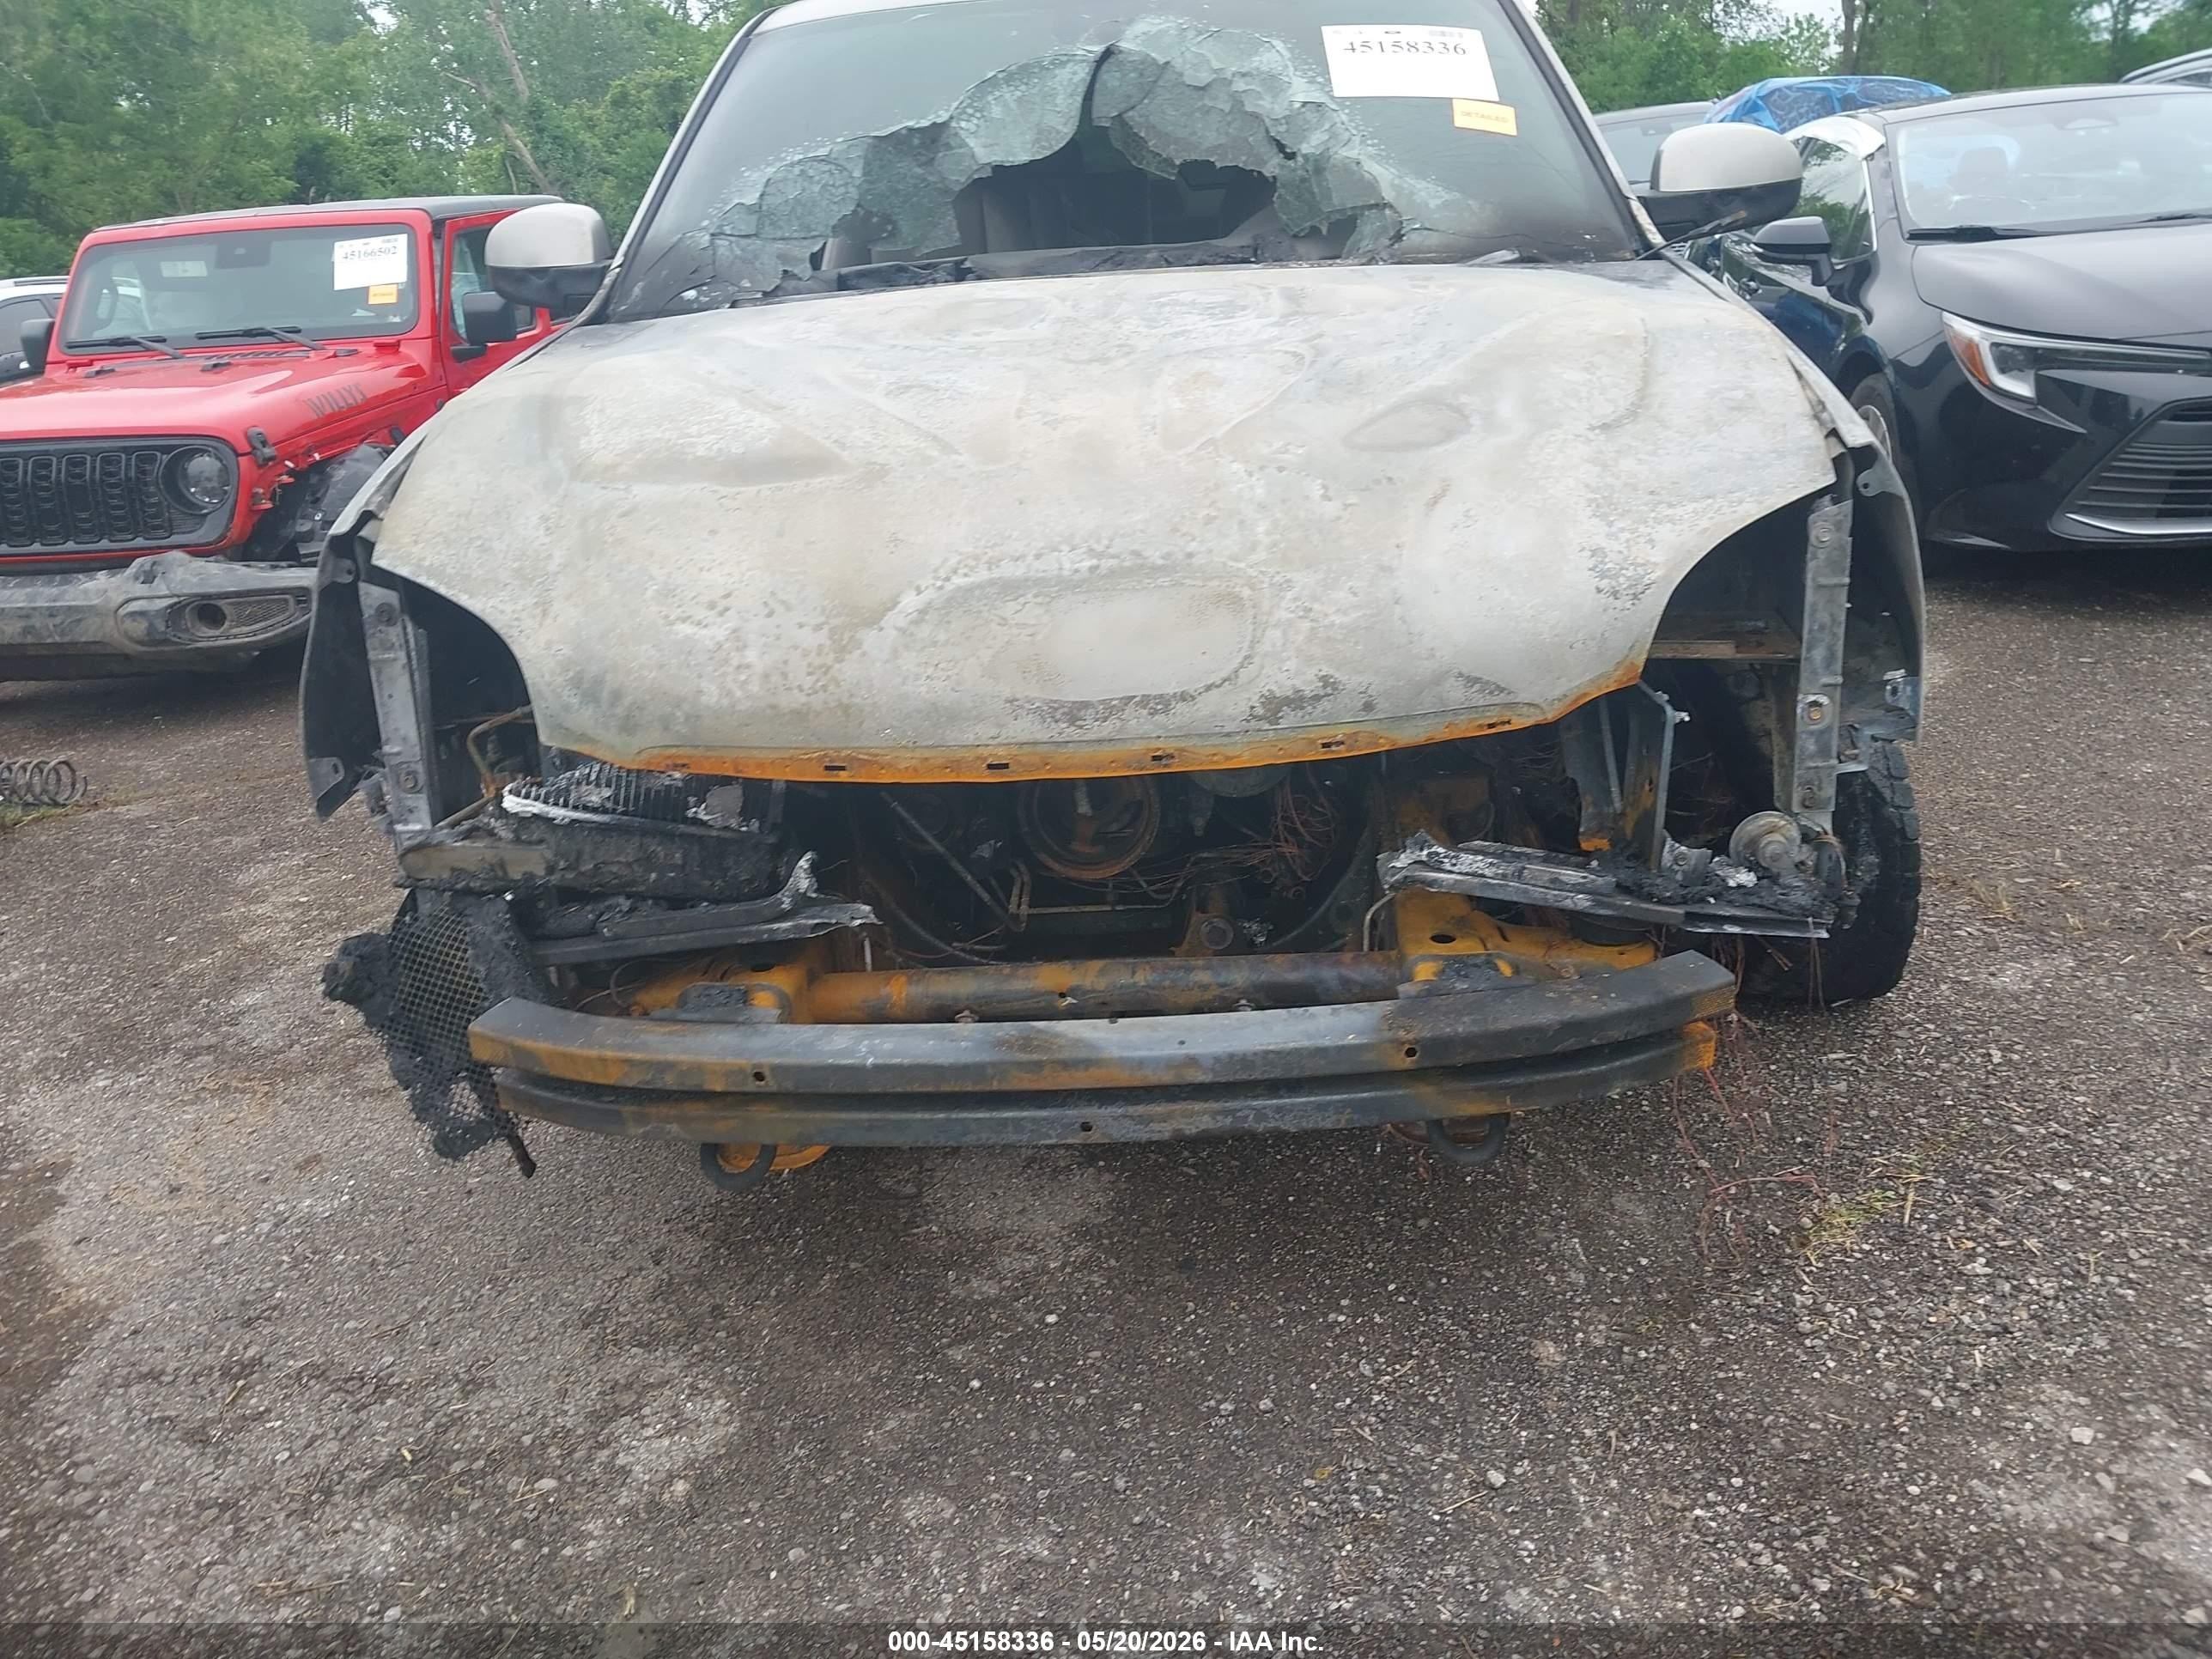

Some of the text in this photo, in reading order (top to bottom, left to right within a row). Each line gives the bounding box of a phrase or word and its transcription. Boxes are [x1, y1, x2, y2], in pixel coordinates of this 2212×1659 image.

[1342, 40, 1467, 56] 45158336
[342, 246, 398, 260] 45166502
[304, 384, 367, 418] WILLYS
